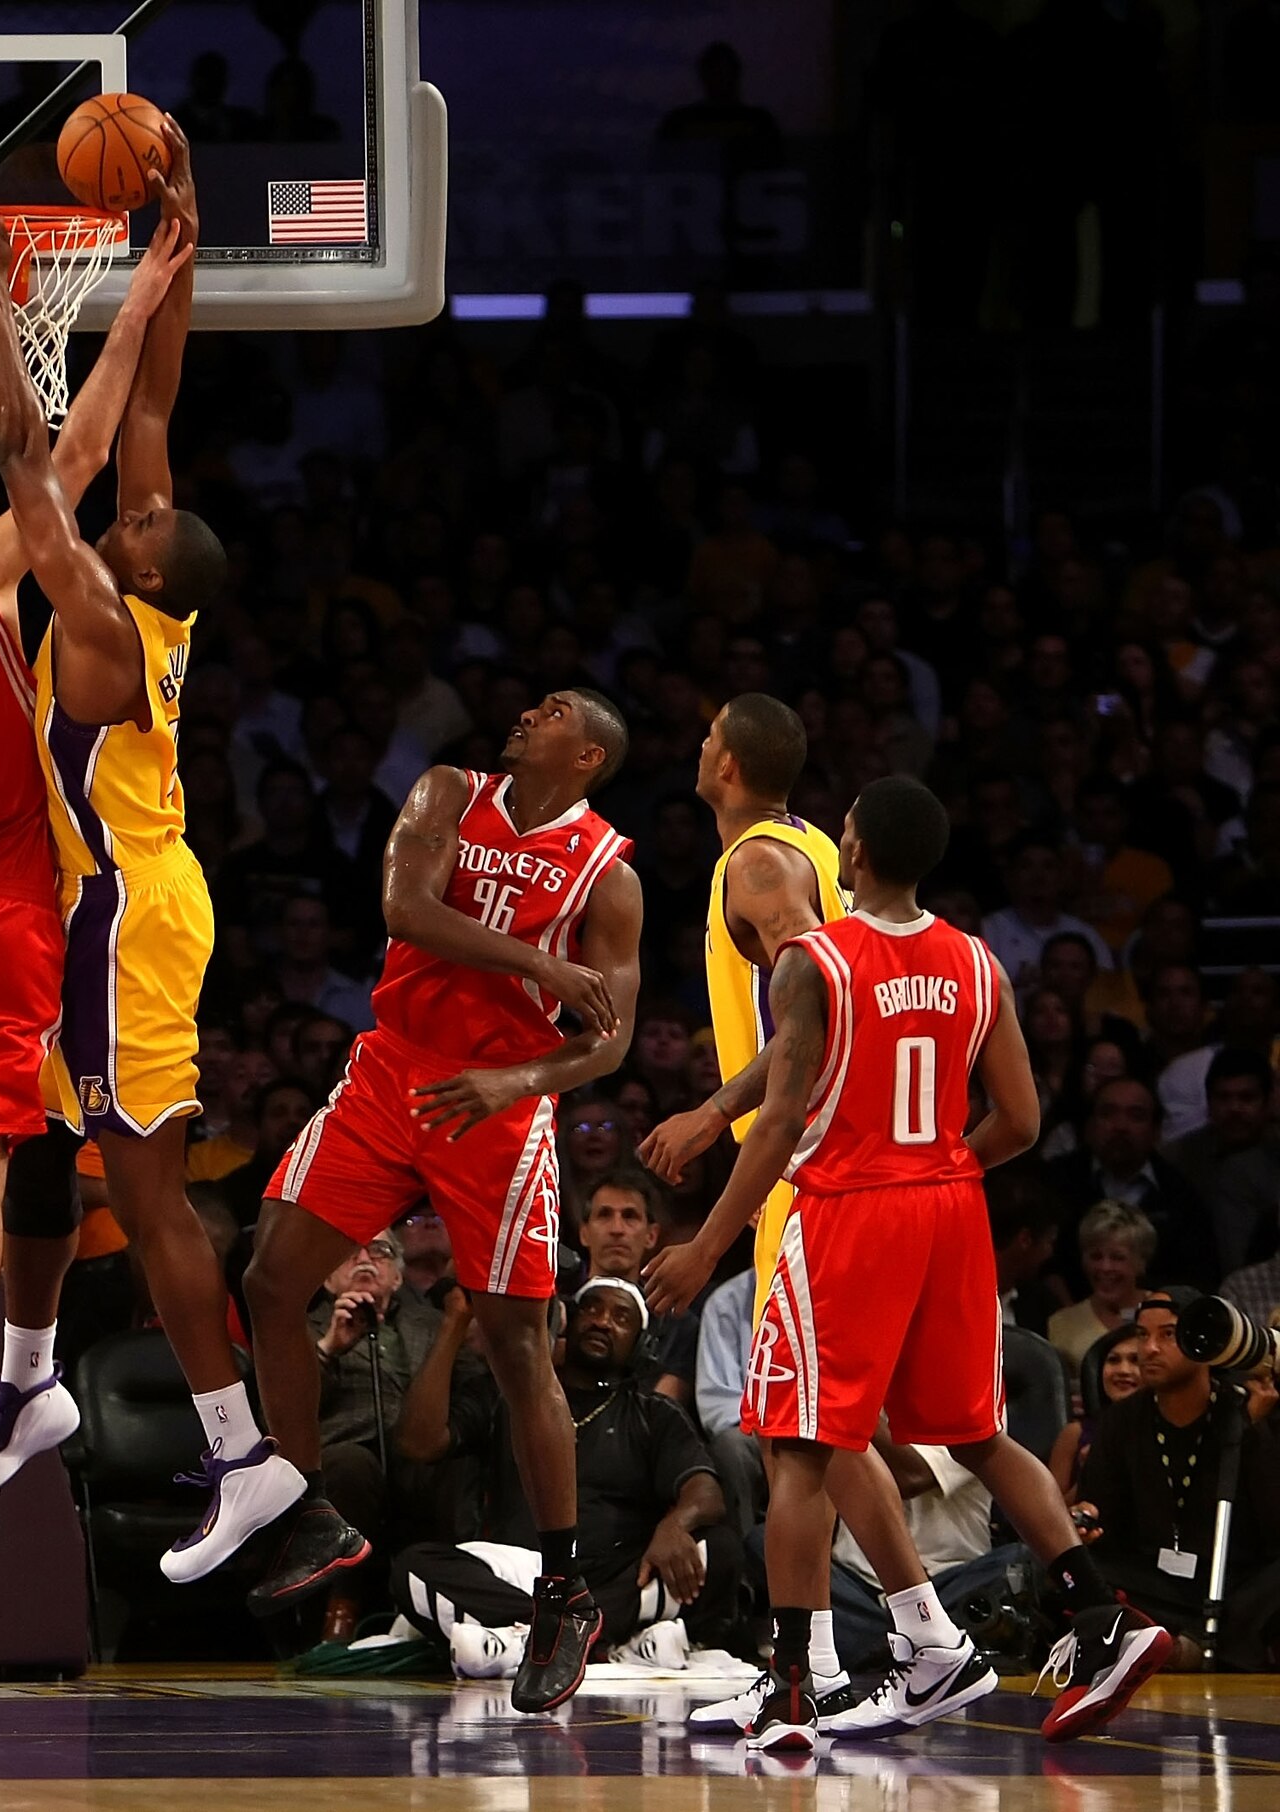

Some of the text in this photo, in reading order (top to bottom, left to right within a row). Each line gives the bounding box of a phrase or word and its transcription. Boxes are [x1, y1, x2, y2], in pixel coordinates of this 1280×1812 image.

[458, 836, 568, 893] ROCKETS
[473, 878, 524, 935] 96
[873, 974, 959, 1018] BROOKS
[892, 1035, 937, 1145] 0
